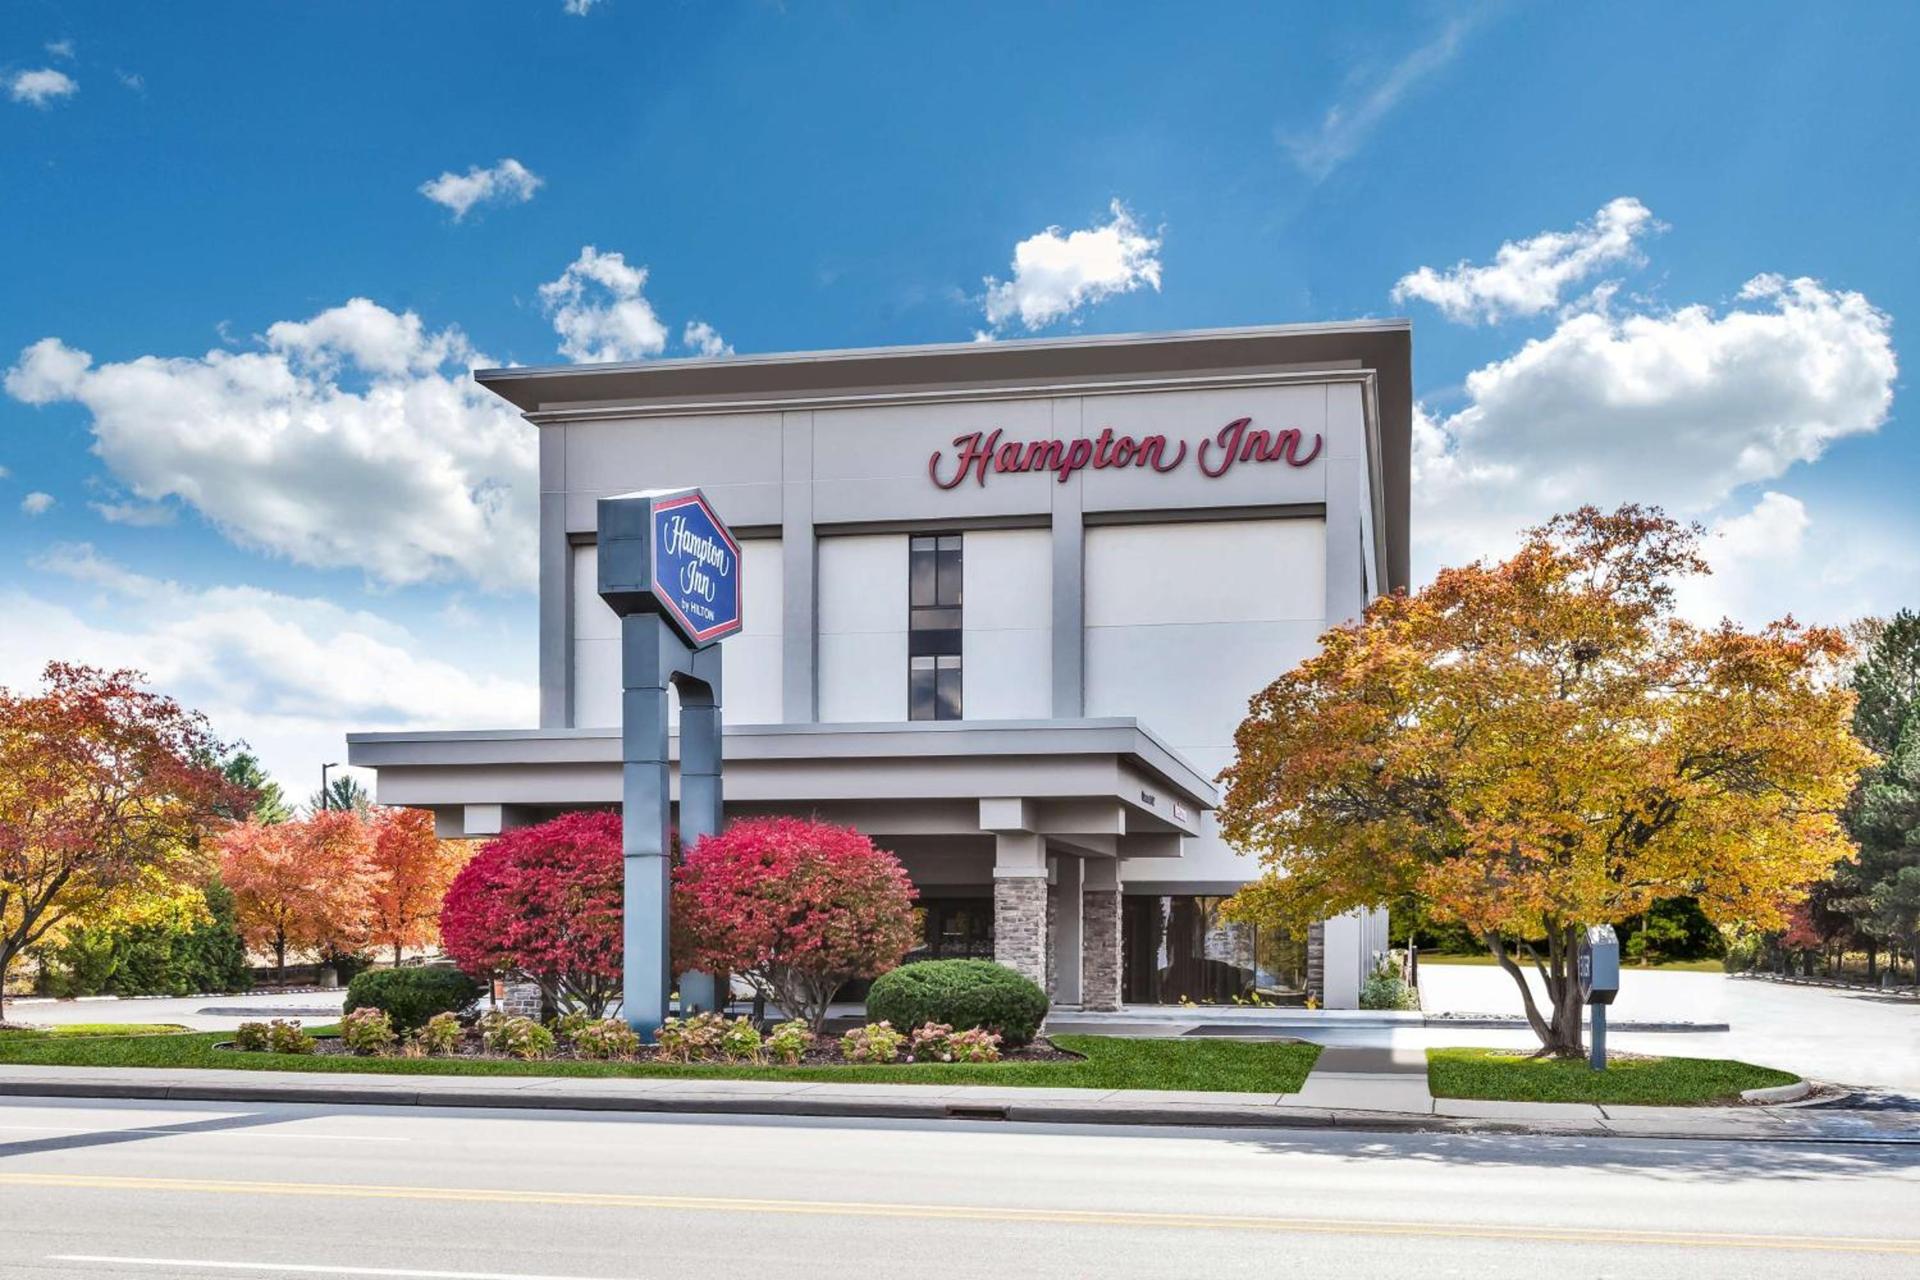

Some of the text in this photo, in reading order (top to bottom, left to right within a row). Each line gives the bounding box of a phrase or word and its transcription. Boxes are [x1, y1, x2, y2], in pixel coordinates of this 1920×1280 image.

[929, 417, 1322, 490] Hampton Inn
[664, 515, 729, 577] Hampton
[680, 560, 715, 602] Inn
[681, 597, 715, 621] by HILTON
